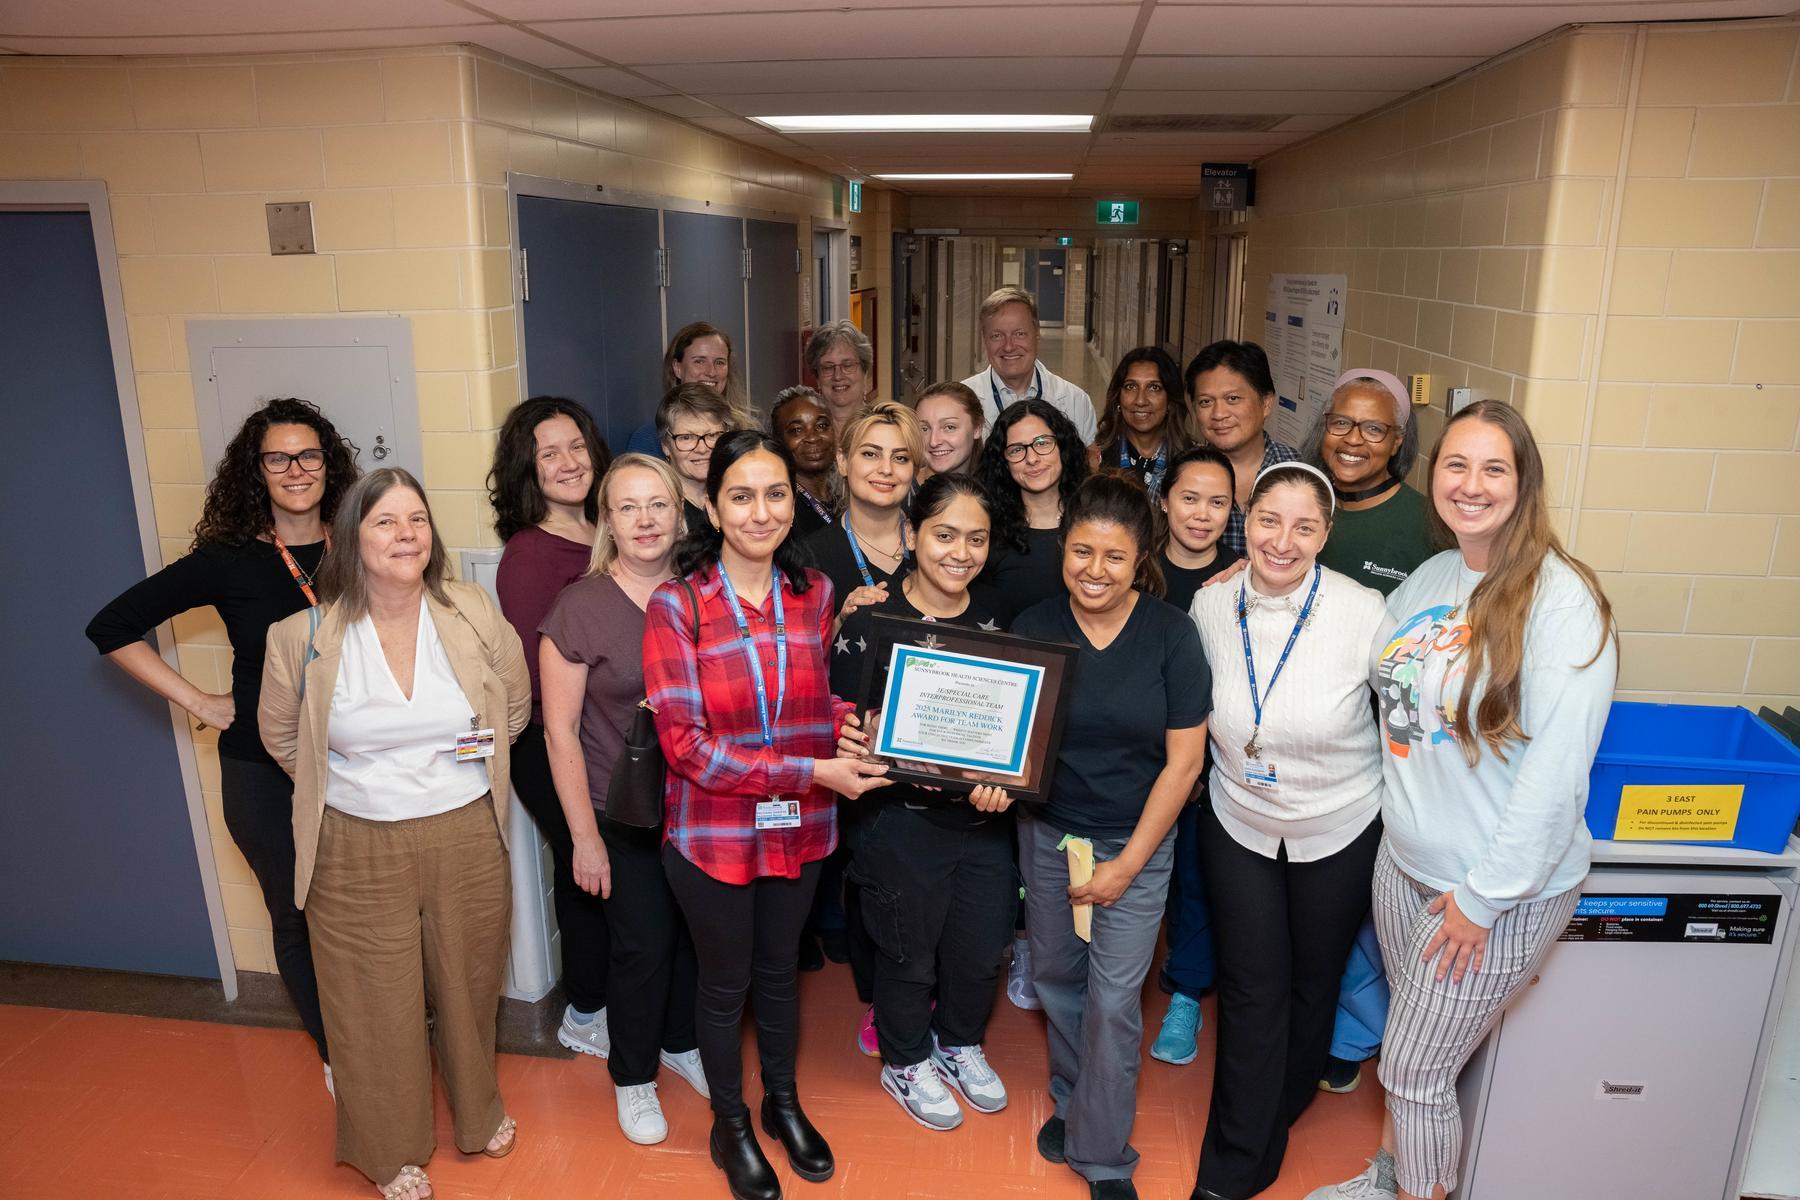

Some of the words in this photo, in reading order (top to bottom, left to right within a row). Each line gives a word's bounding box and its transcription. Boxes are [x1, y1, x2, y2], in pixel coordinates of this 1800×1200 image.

[1204, 168, 1237, 176] Elevator
[914, 667, 950, 677] SUNNYBROOK
[920, 692, 984, 707] INTERPROFESSIONAL
[973, 692, 989, 700] CARE
[932, 707, 968, 717] MARILYN
[969, 713, 1002, 723] REDDICK
[912, 712, 939, 721] AWARD
[958, 719, 979, 727] TEAM
[980, 722, 1003, 731] WORK
[1584, 900, 1607, 908] keeps
